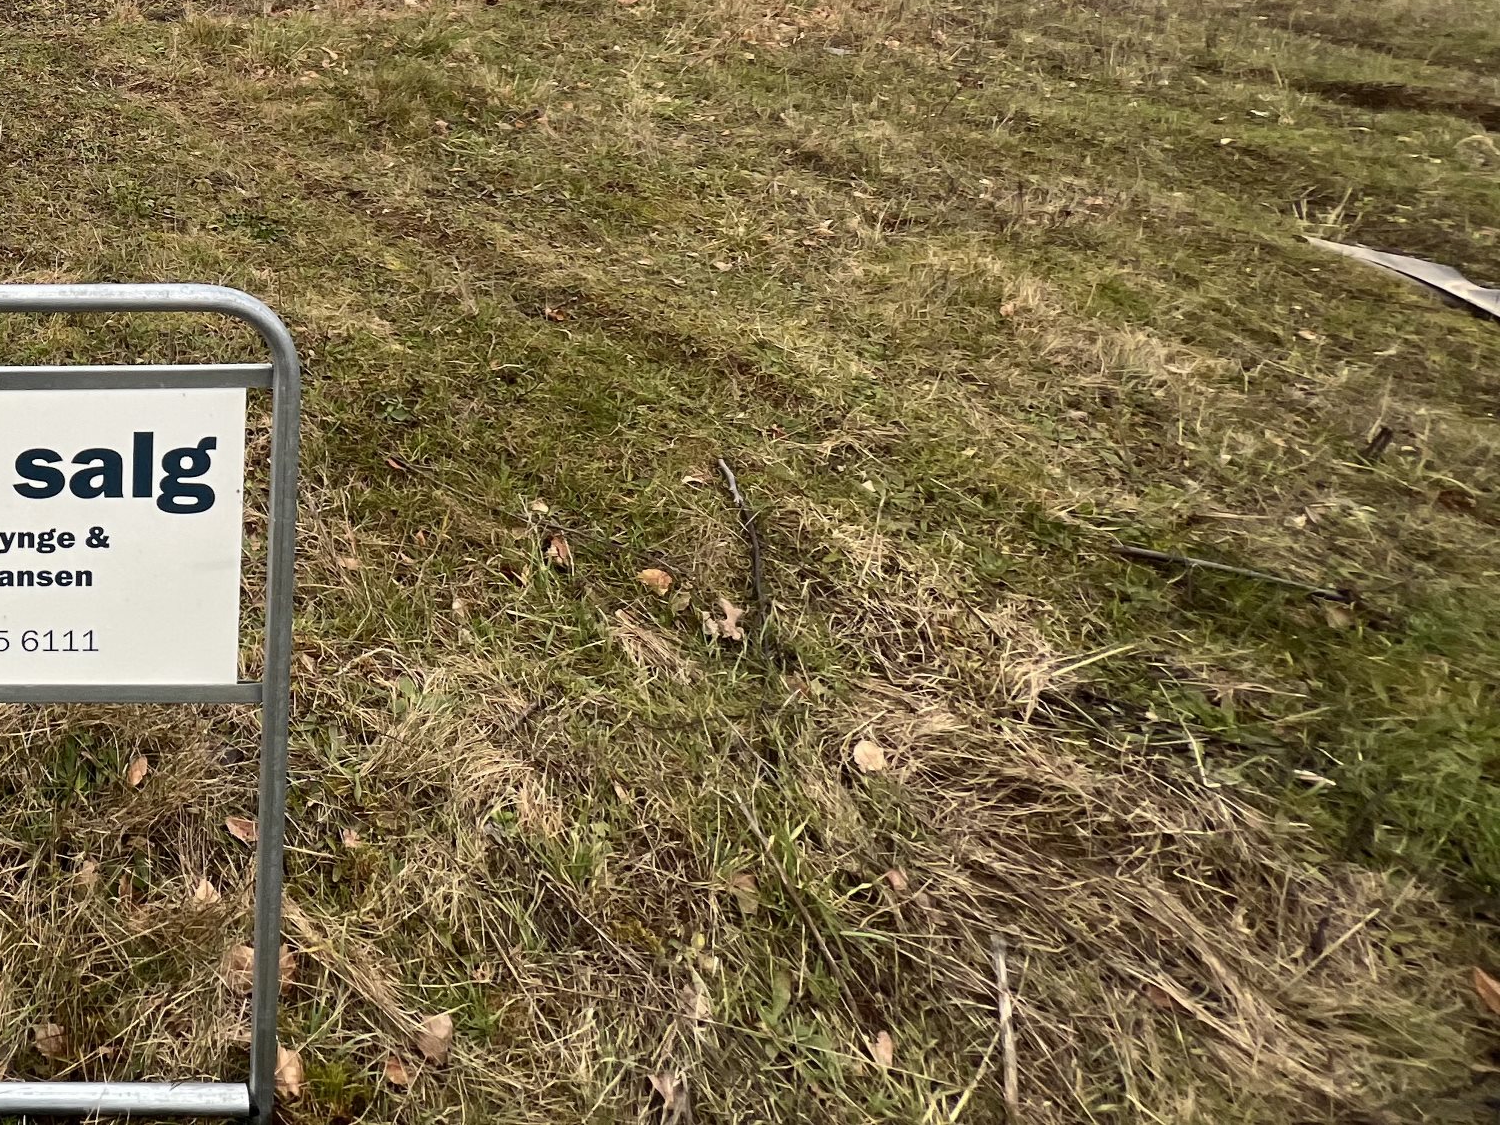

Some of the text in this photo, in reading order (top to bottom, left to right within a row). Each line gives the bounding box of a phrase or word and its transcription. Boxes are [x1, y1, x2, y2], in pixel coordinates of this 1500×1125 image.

[12, 431, 218, 515] salg
[85, 526, 110, 549] &
[21, 629, 99, 653] 6111
